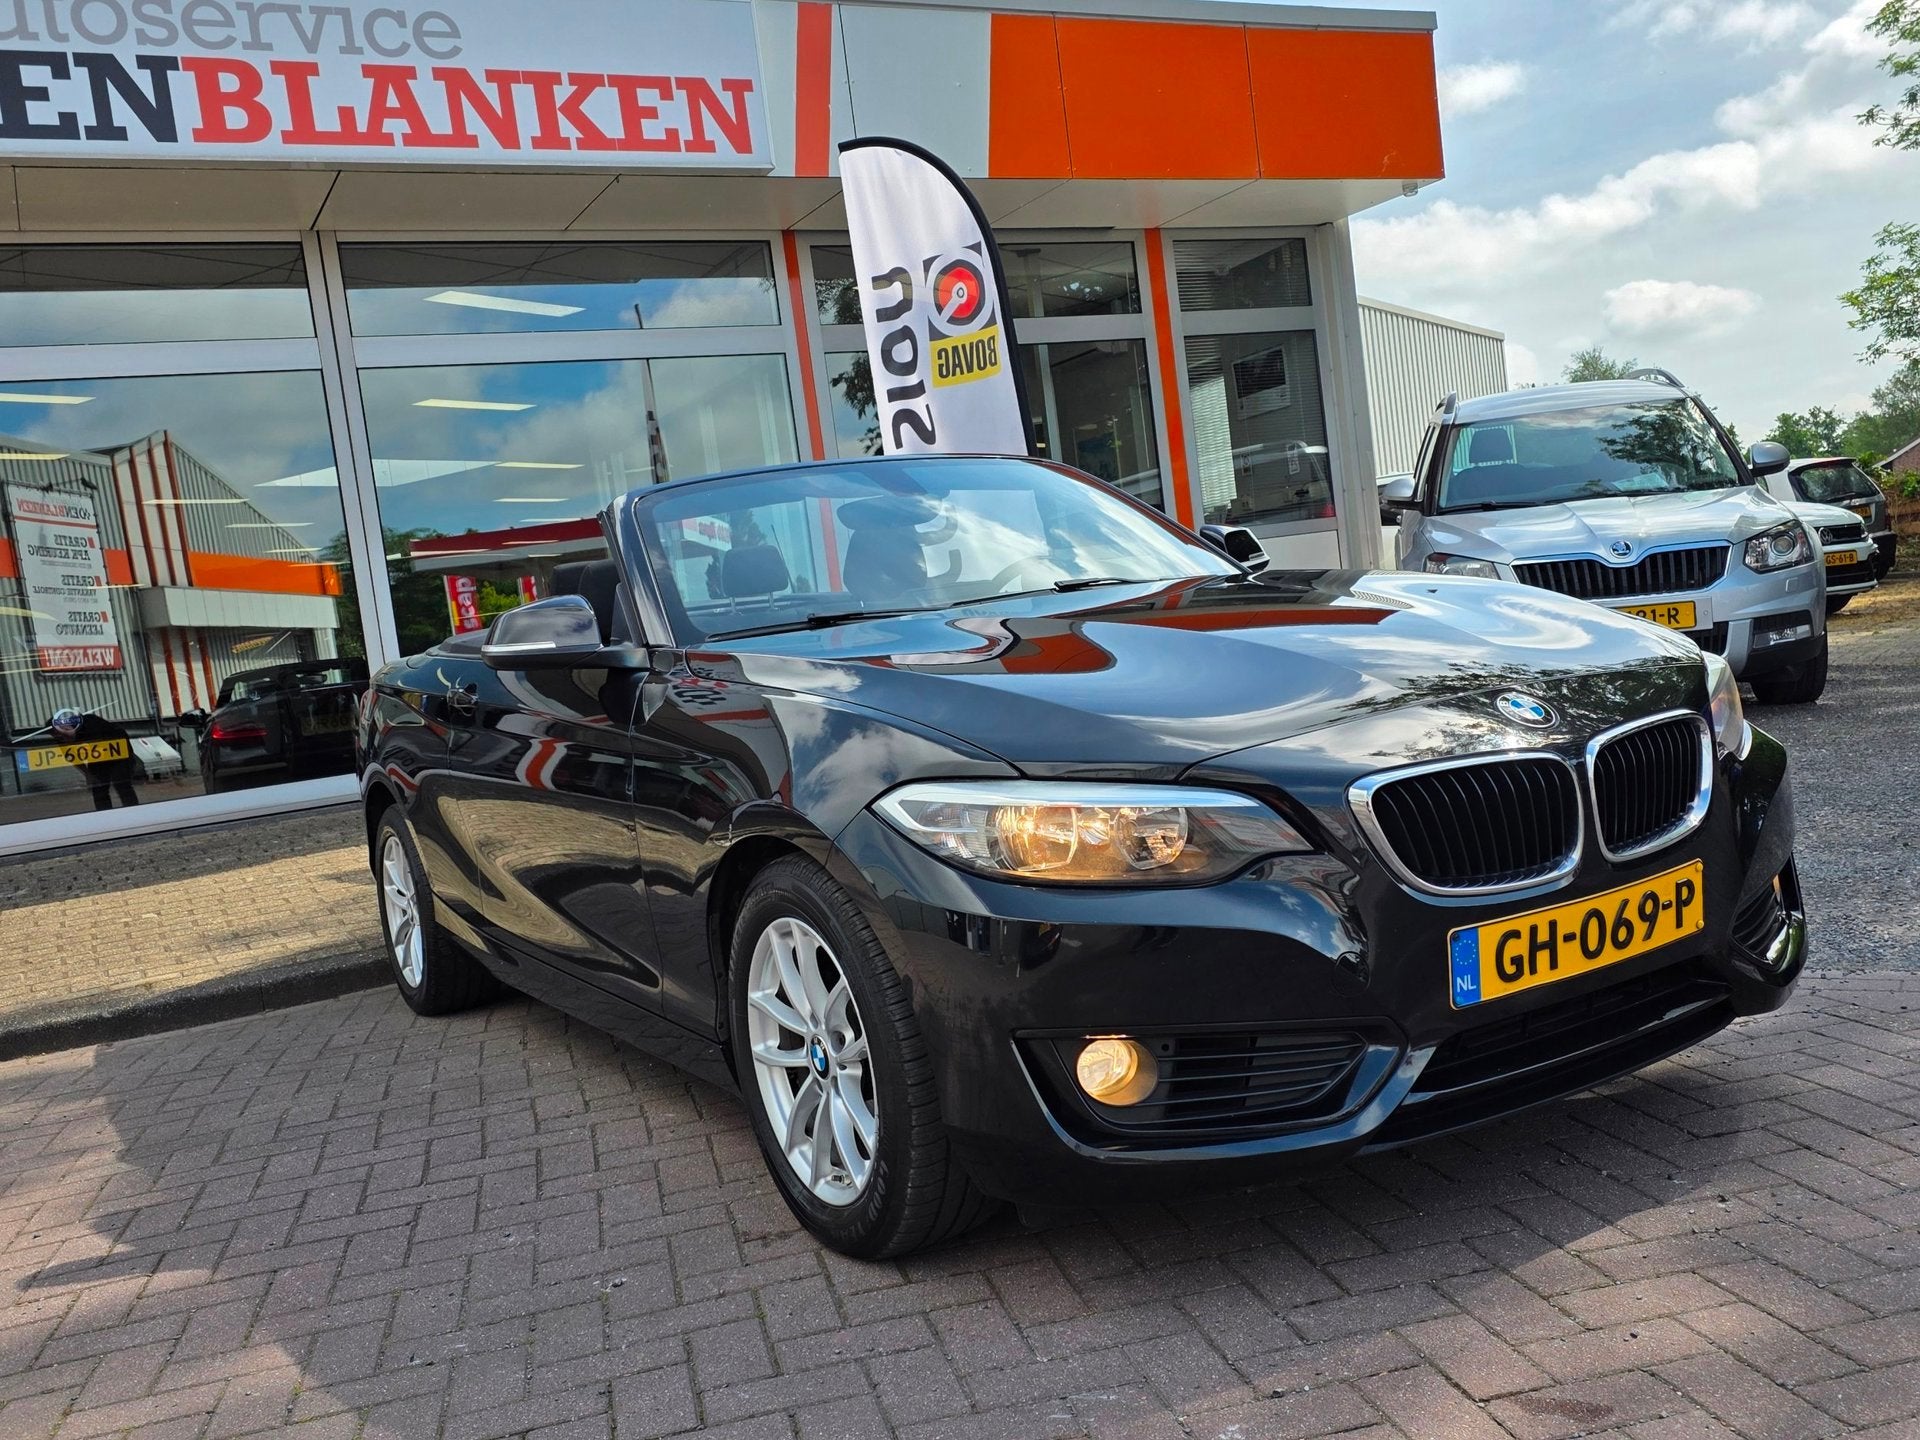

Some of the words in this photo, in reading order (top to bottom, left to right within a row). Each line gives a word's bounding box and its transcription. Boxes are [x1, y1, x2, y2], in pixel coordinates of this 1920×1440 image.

[34, 742, 122, 767] JP-606-N
[1495, 878, 1696, 983] GH-069-P
[1456, 974, 1477, 993] NL
